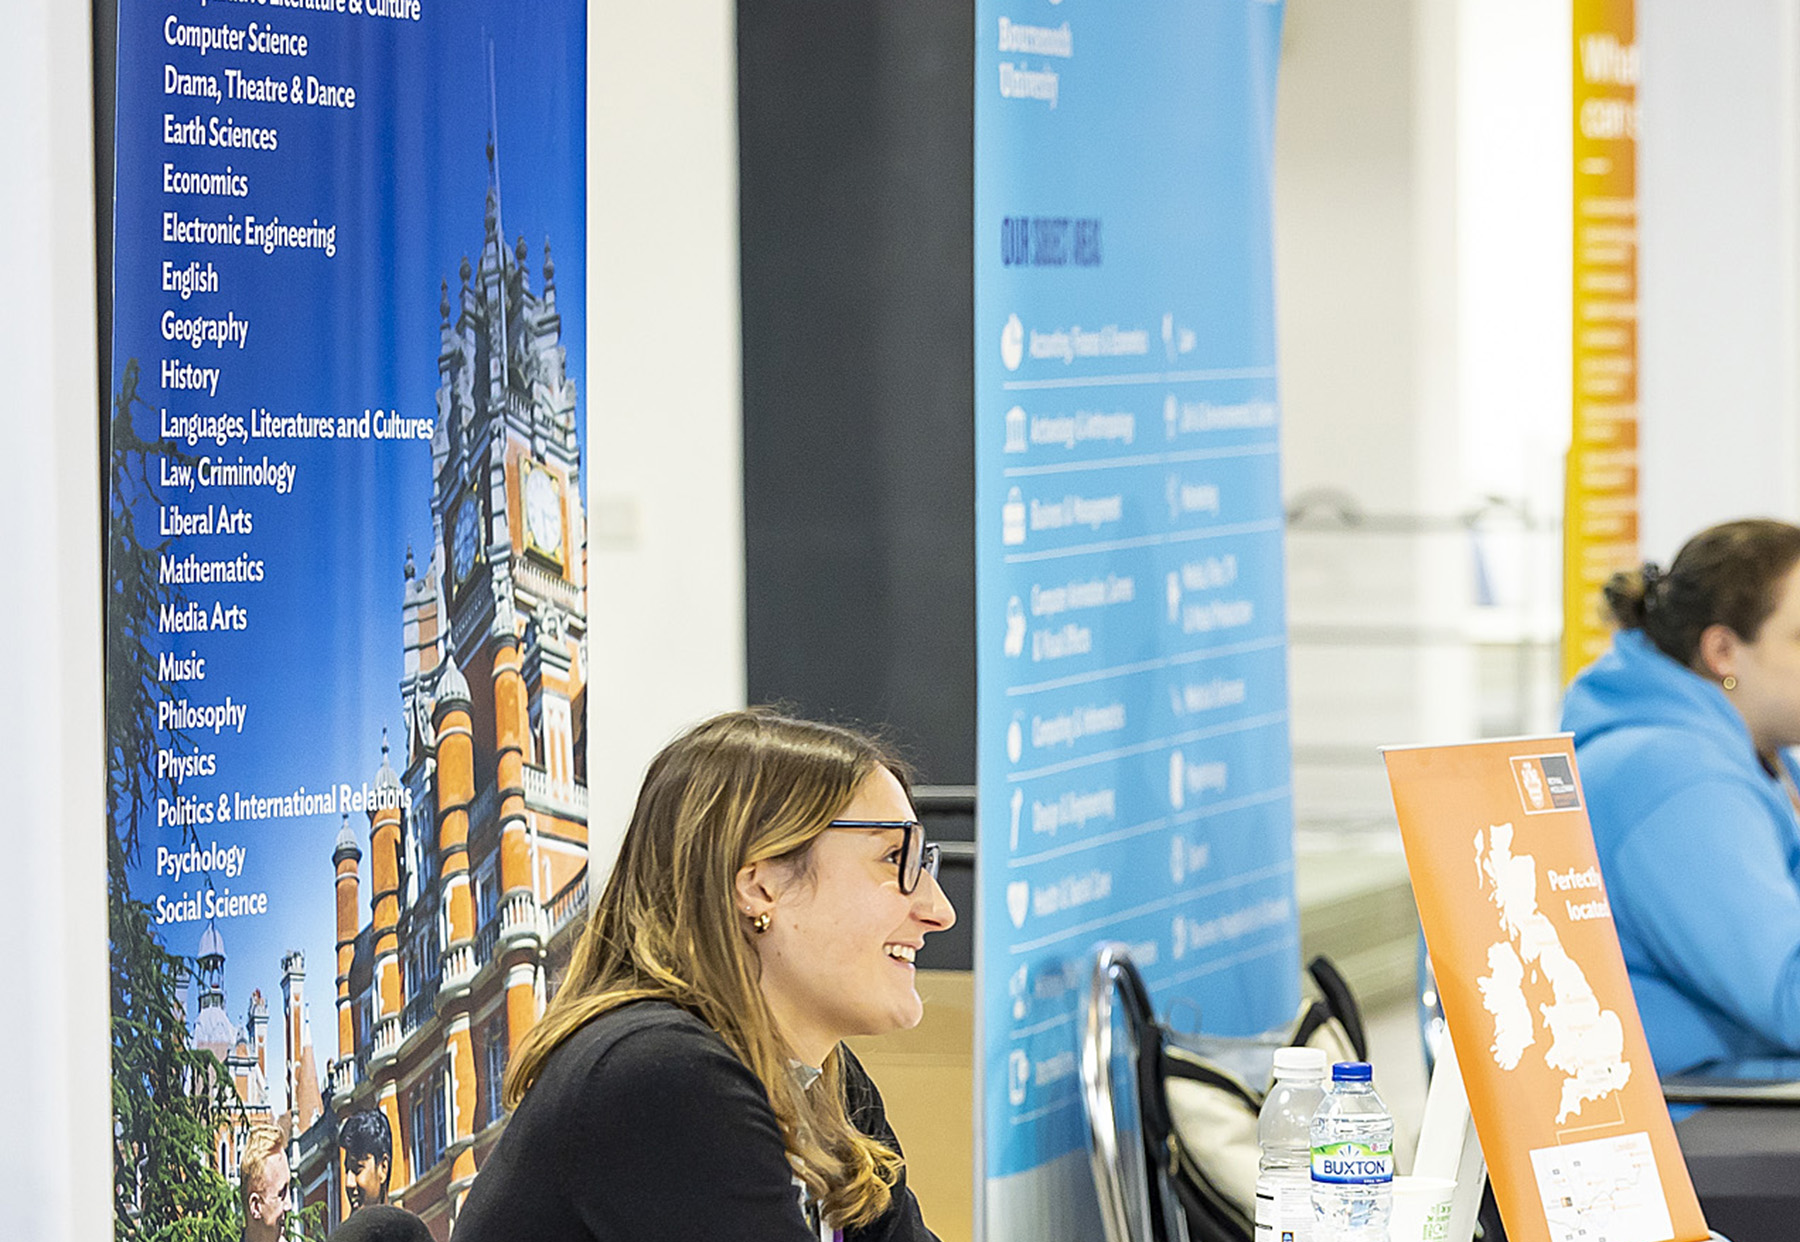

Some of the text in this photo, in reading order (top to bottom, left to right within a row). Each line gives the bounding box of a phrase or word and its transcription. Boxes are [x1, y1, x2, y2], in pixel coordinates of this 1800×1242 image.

[164, 15, 308, 57] Computer Science
[164, 64, 356, 109] Drama, Theatre & Dance
[164, 113, 278, 151] Earth Sciences
[163, 163, 248, 197] Economics
[163, 211, 337, 258] Electronic Engineering
[162, 261, 218, 300] English
[161, 310, 249, 349] Geography
[161, 358, 220, 397] History
[161, 408, 434, 447] Languages, Literatures and Cultures
[160, 455, 297, 494] Law, Criminology
[160, 504, 253, 536] Liberal Arts
[159, 552, 264, 585] Mathematics
[159, 601, 248, 633] Media Arts
[158, 650, 205, 682] Music
[158, 696, 247, 735] Philosophy
[158, 746, 217, 785] Physics
[157, 782, 412, 827] Politics & International Relations
[157, 841, 246, 882] Psychology
[1547, 866, 1602, 891] Perfectly
[156, 887, 268, 925] Social Science
[1324, 1160, 1385, 1175] BUXTON
